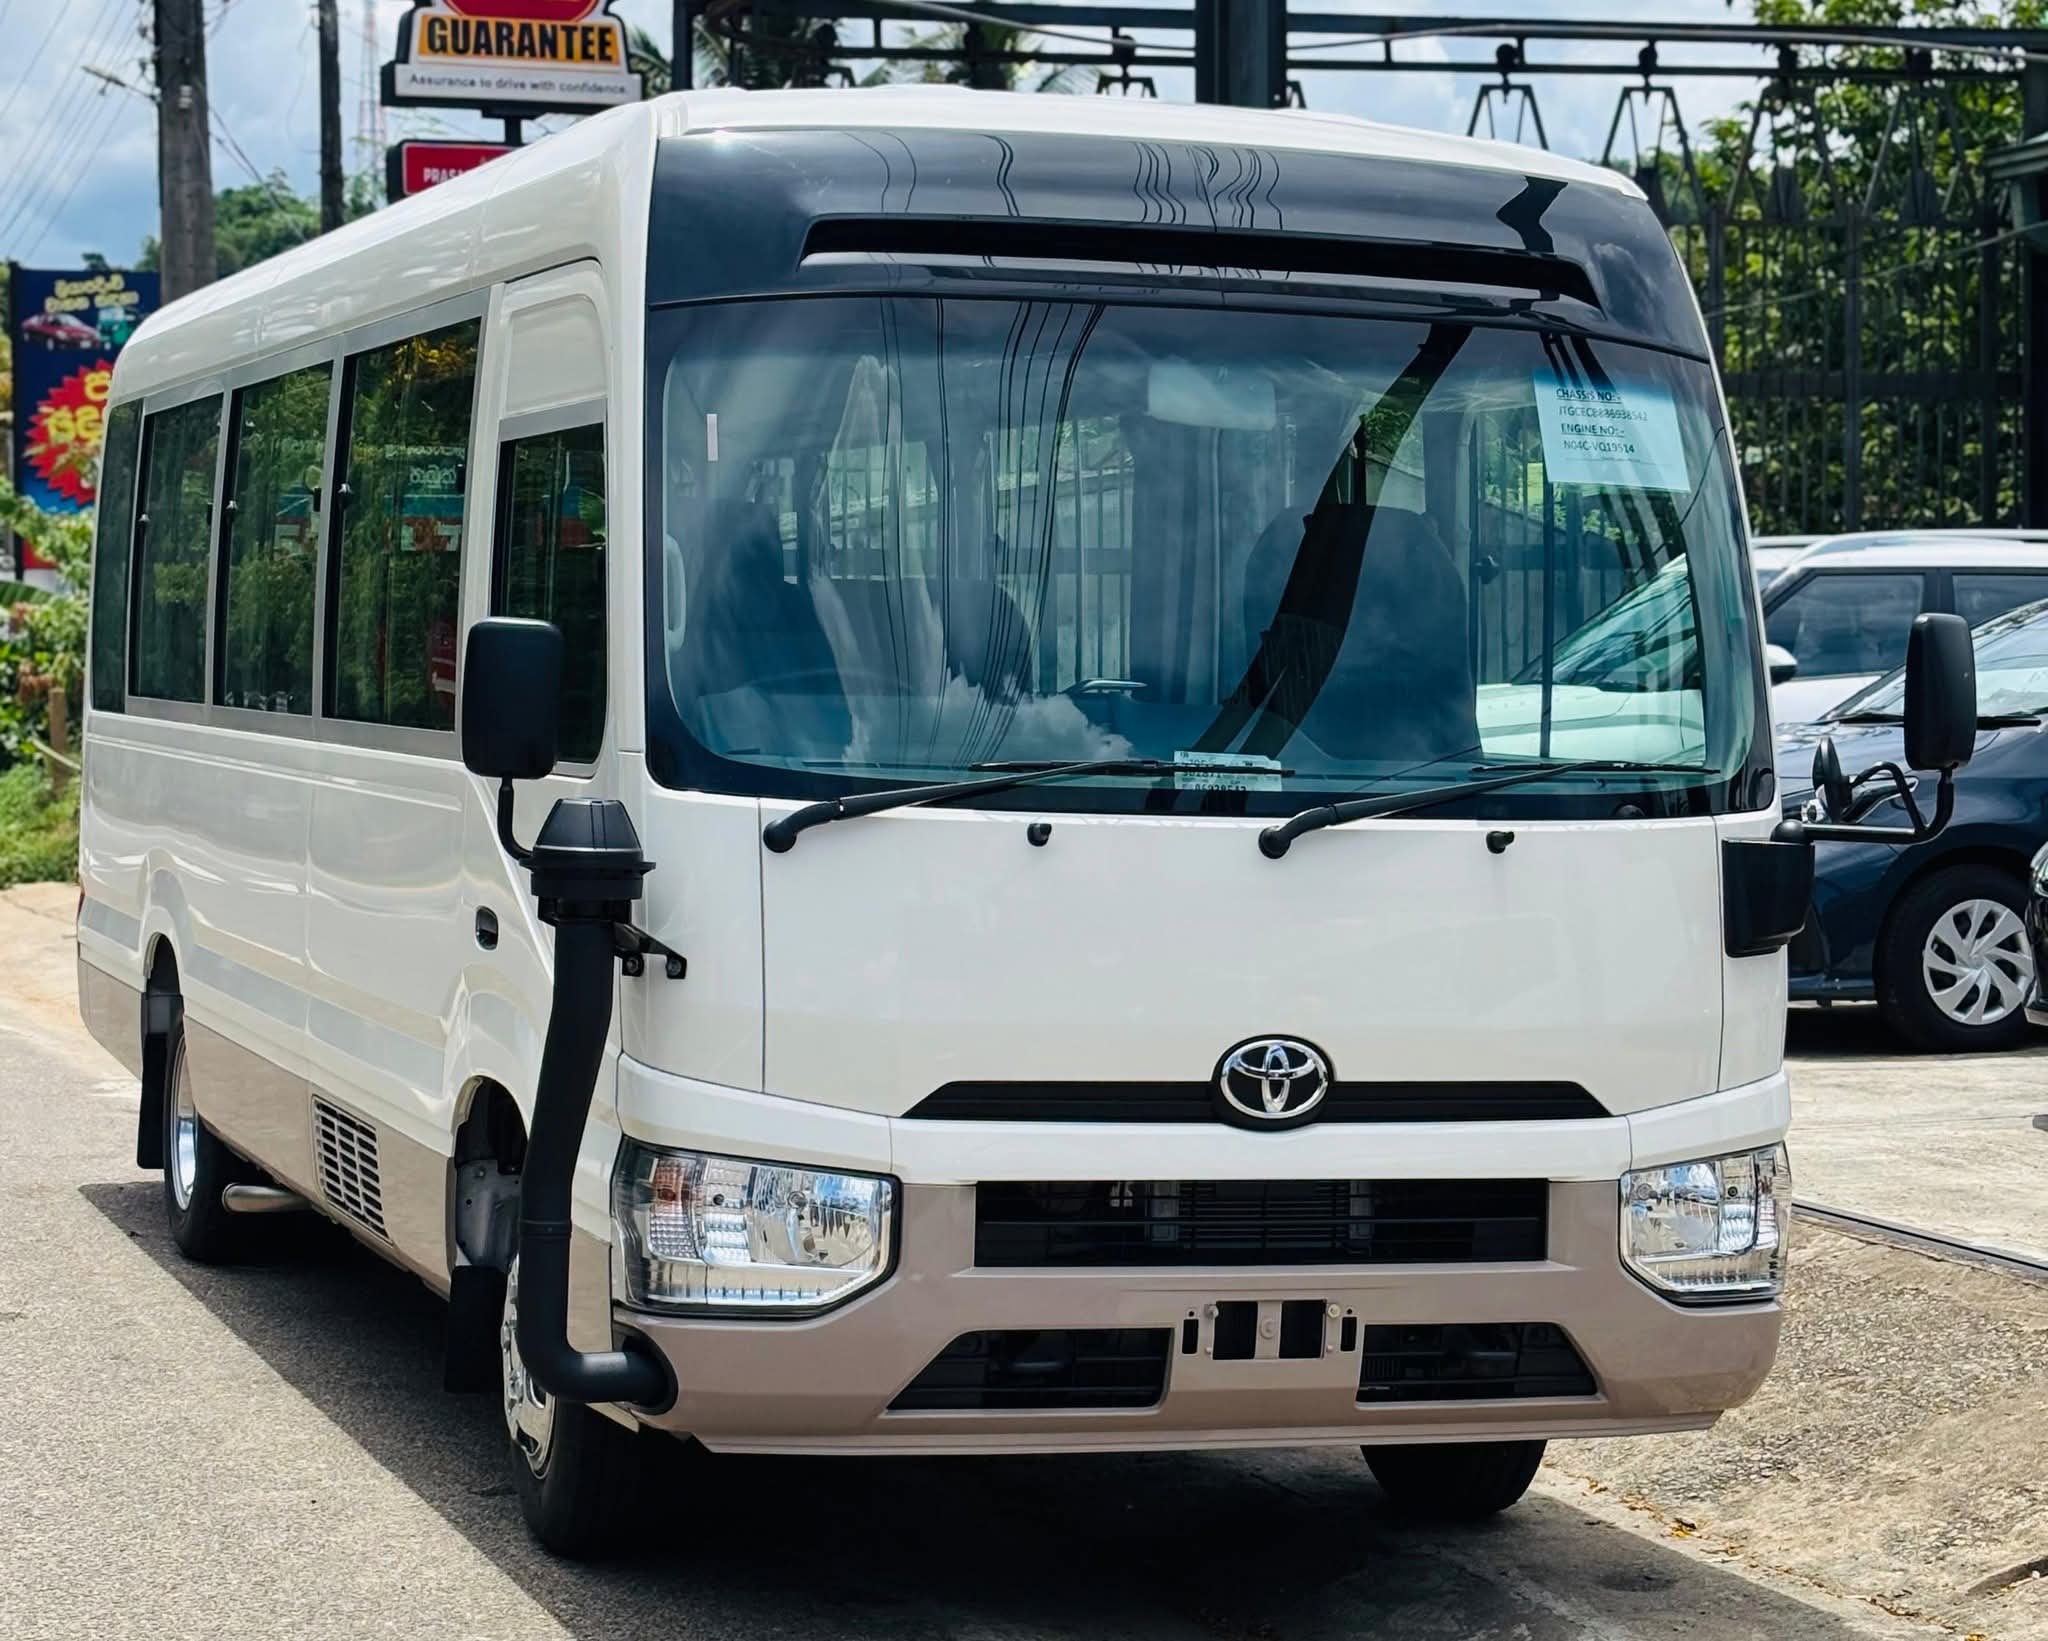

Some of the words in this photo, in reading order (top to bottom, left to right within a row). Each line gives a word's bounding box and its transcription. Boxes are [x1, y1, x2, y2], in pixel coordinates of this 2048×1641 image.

[427, 16, 614, 62] GUARANTEE
[409, 73, 476, 88] Assurance
[480, 76, 493, 89] to
[495, 77, 526, 91] drive
[530, 78, 556, 92] with
[560, 79, 626, 94] confidence
[1556, 388, 1595, 401] CHASSIS
[1561, 423, 1597, 434] ENGINE
